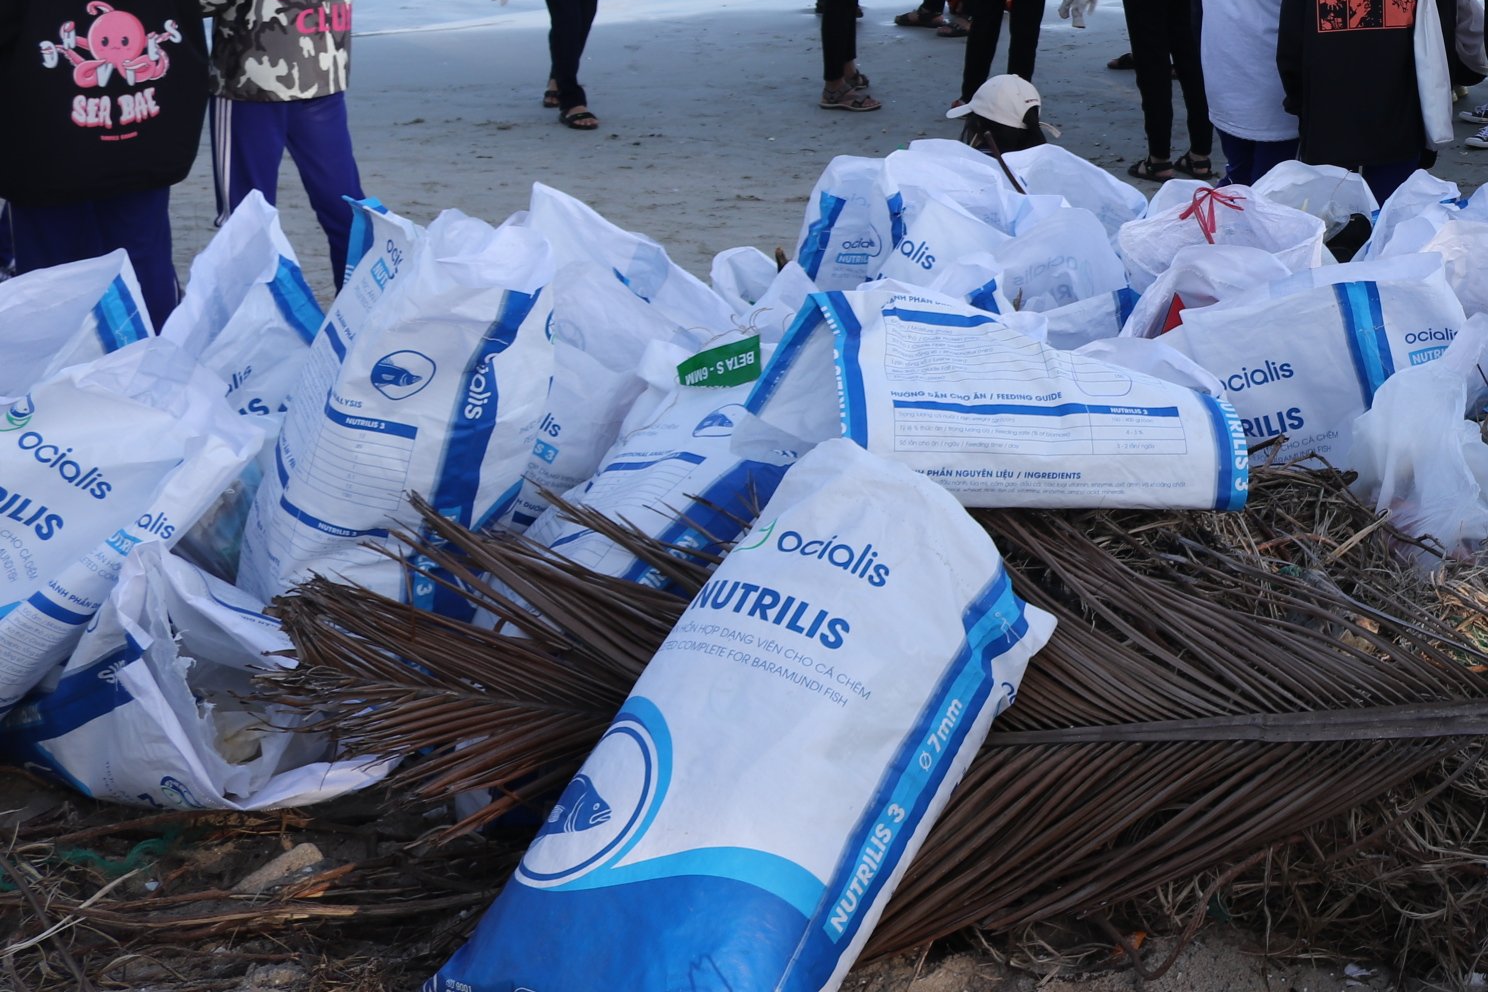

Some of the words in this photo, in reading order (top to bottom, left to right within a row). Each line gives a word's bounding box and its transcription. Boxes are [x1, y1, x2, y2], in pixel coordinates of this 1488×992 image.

[71, 95, 112, 129] SEA
[117, 87, 160, 125] BAE
[685, 363, 709, 386] 6MM
[726, 351, 755, 370] BETA
[996, 393, 1033, 401] FEEDING
[1035, 391, 1063, 402] GUIDE
[345, 416, 379, 429] NUTRILIS
[1240, 407, 1304, 437] RILIS
[18, 432, 112, 500] ocialis
[956, 468, 993, 478] NGUYÊN
[996, 469, 1014, 480] LIỆU
[1024, 471, 1081, 480] INGREDIENTS
[1234, 476, 1249, 492] 3
[136, 512, 175, 539] alis
[317, 521, 351, 537] NUTRILIS
[777, 529, 890, 588] ocialis
[691, 580, 850, 650] NUTRILIS
[677, 639, 727, 658] COMPLETE
[727, 649, 751, 665] FOR
[751, 657, 823, 694] BARAMUNDI
[824, 686, 849, 708] FISH
[784, 647, 813, 668] CHO
[815, 663, 835, 679] CÁ
[832, 826, 893, 934] NUTRILIS
[887, 803, 906, 823] 3
[928, 698, 964, 754] 7mm
